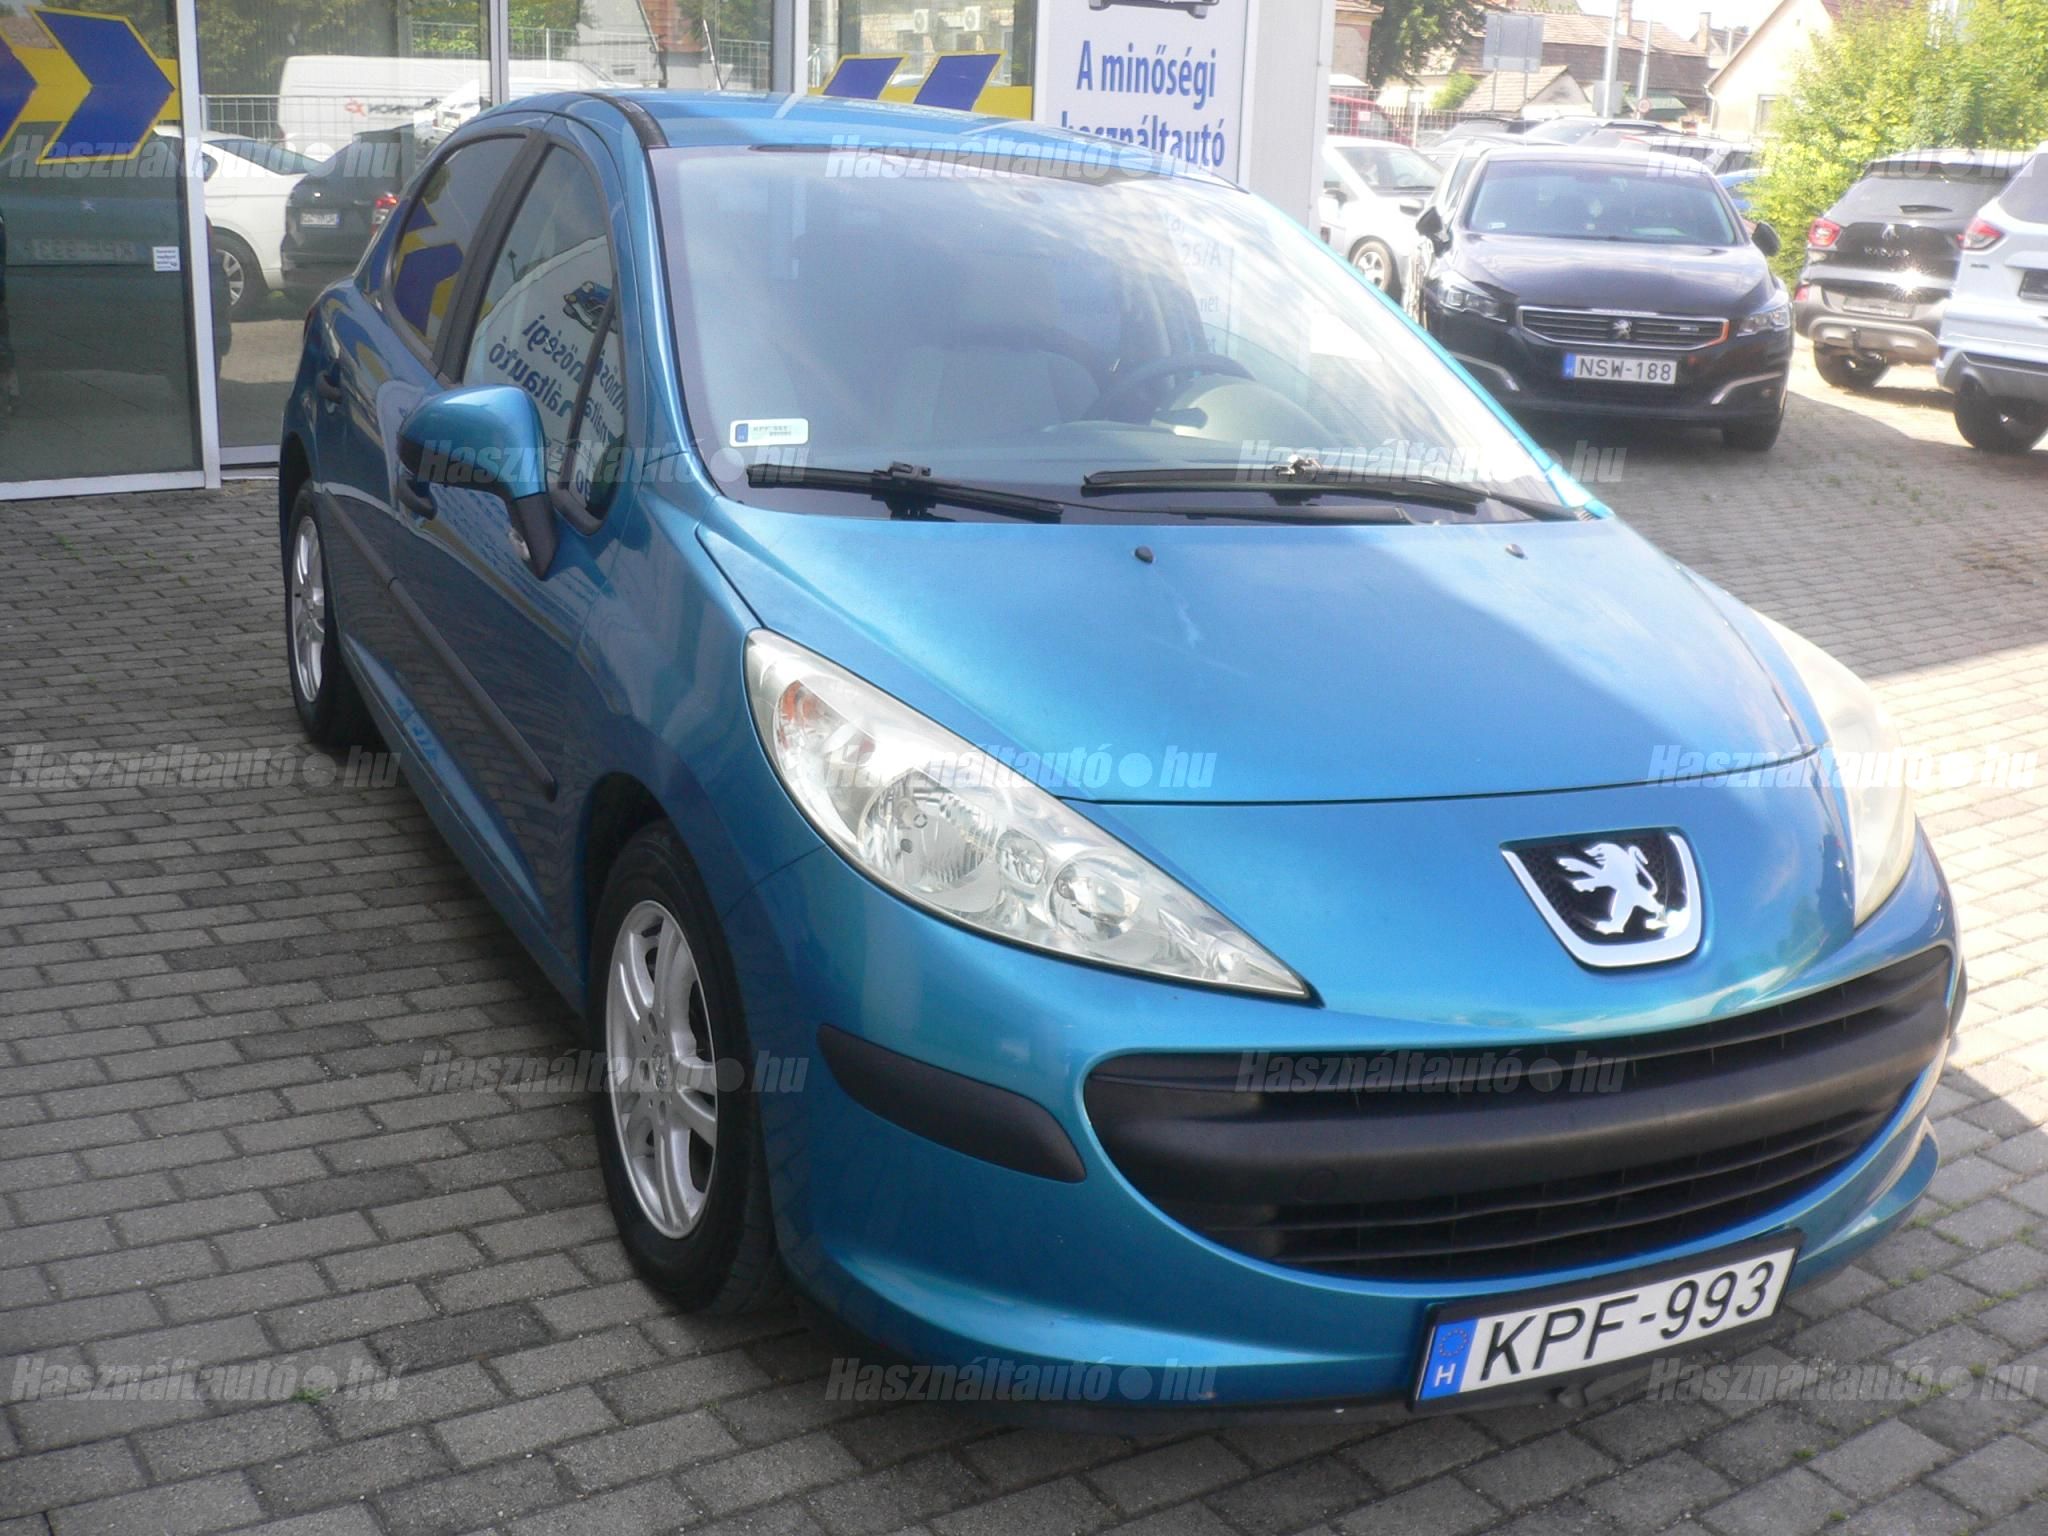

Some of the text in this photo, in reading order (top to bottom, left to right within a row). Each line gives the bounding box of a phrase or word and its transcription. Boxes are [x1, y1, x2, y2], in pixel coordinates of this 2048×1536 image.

[1076, 40, 1216, 110] A minőségi
[1579, 359, 1672, 382] NSW-188
[1434, 1261, 1774, 1388] H KPF-993
